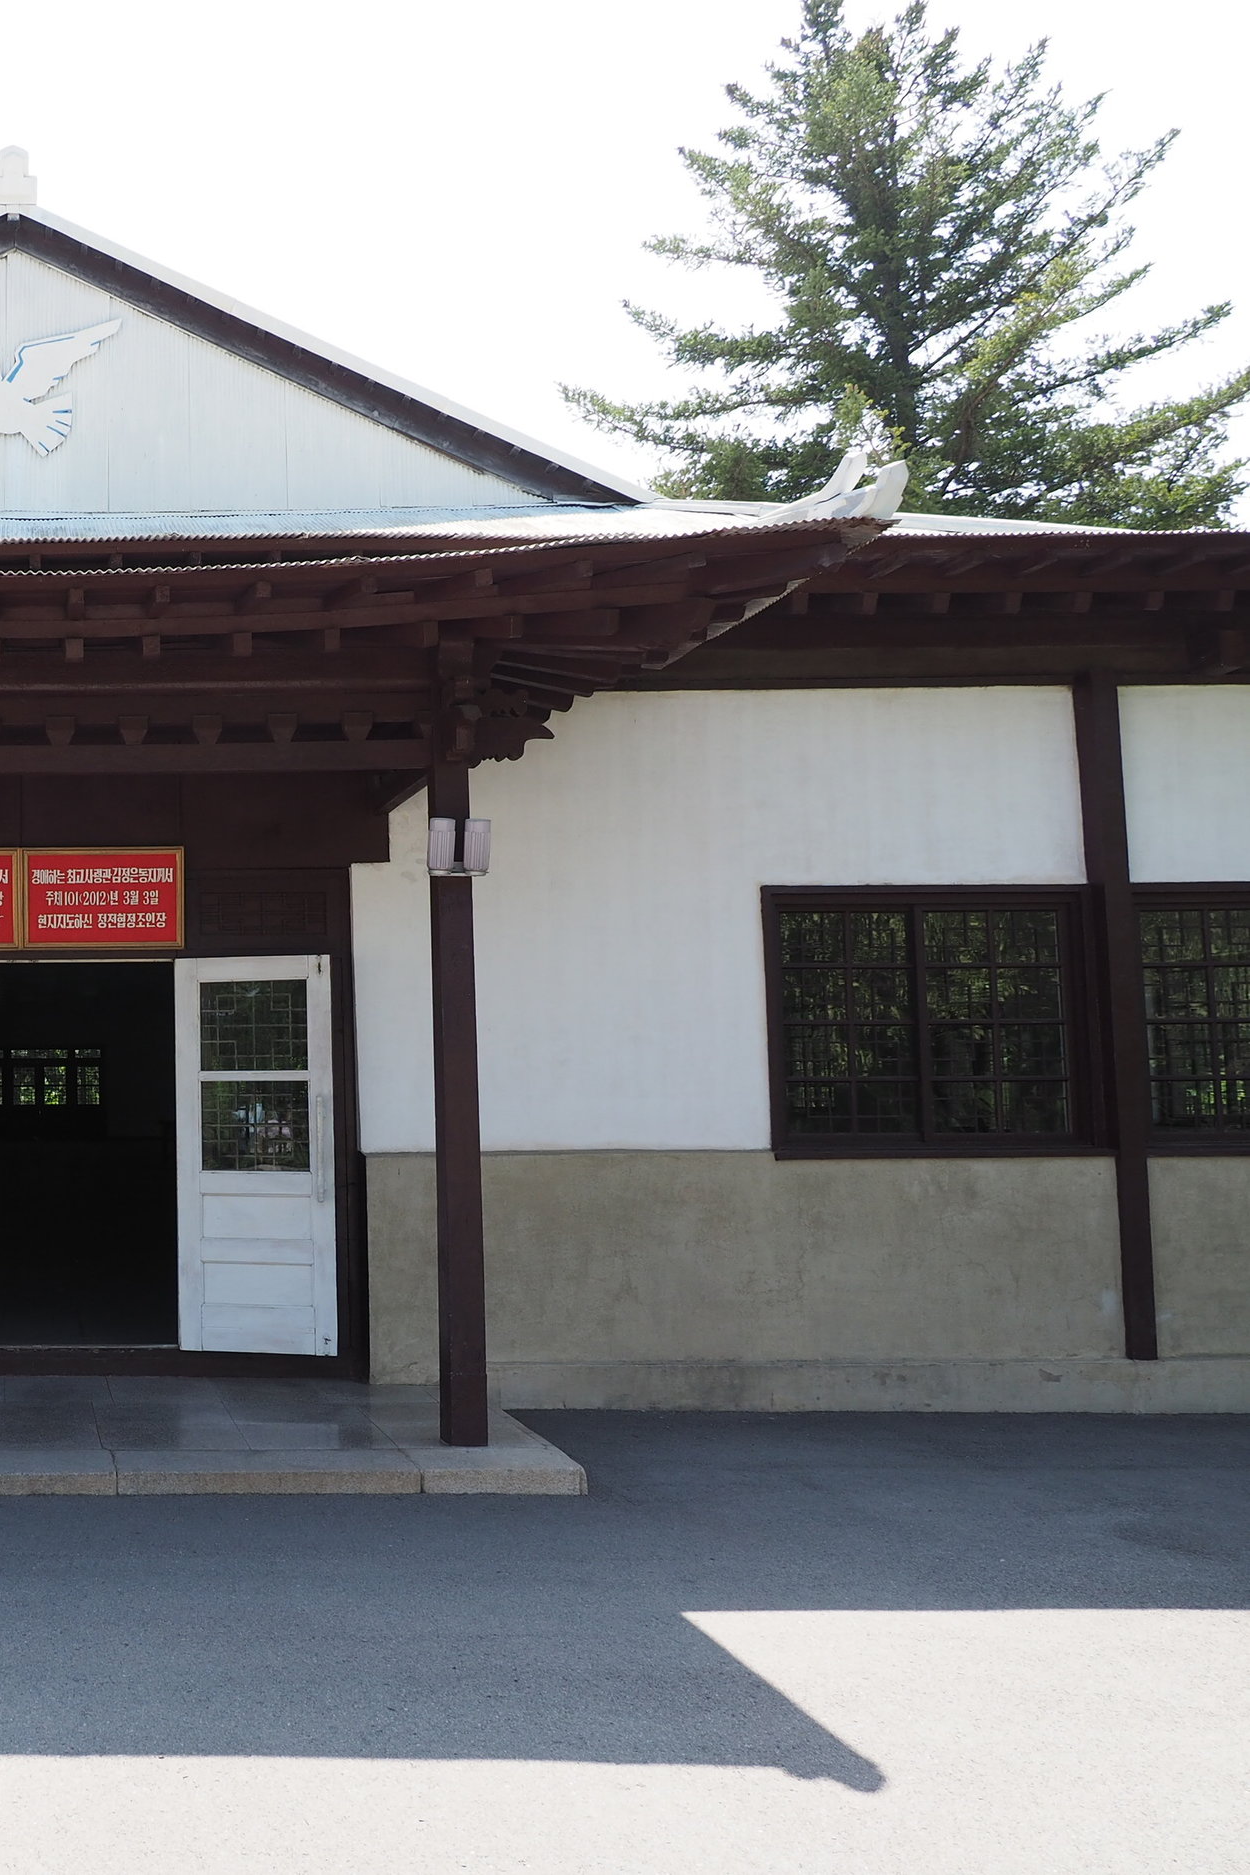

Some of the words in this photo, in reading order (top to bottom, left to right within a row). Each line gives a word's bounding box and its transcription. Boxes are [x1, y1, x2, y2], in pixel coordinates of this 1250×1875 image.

[32, 869, 65, 884] 경애하는
[123, 891, 139, 905] 3월
[143, 890, 159, 905] 3일
[38, 914, 92, 929] 현지지도하신
